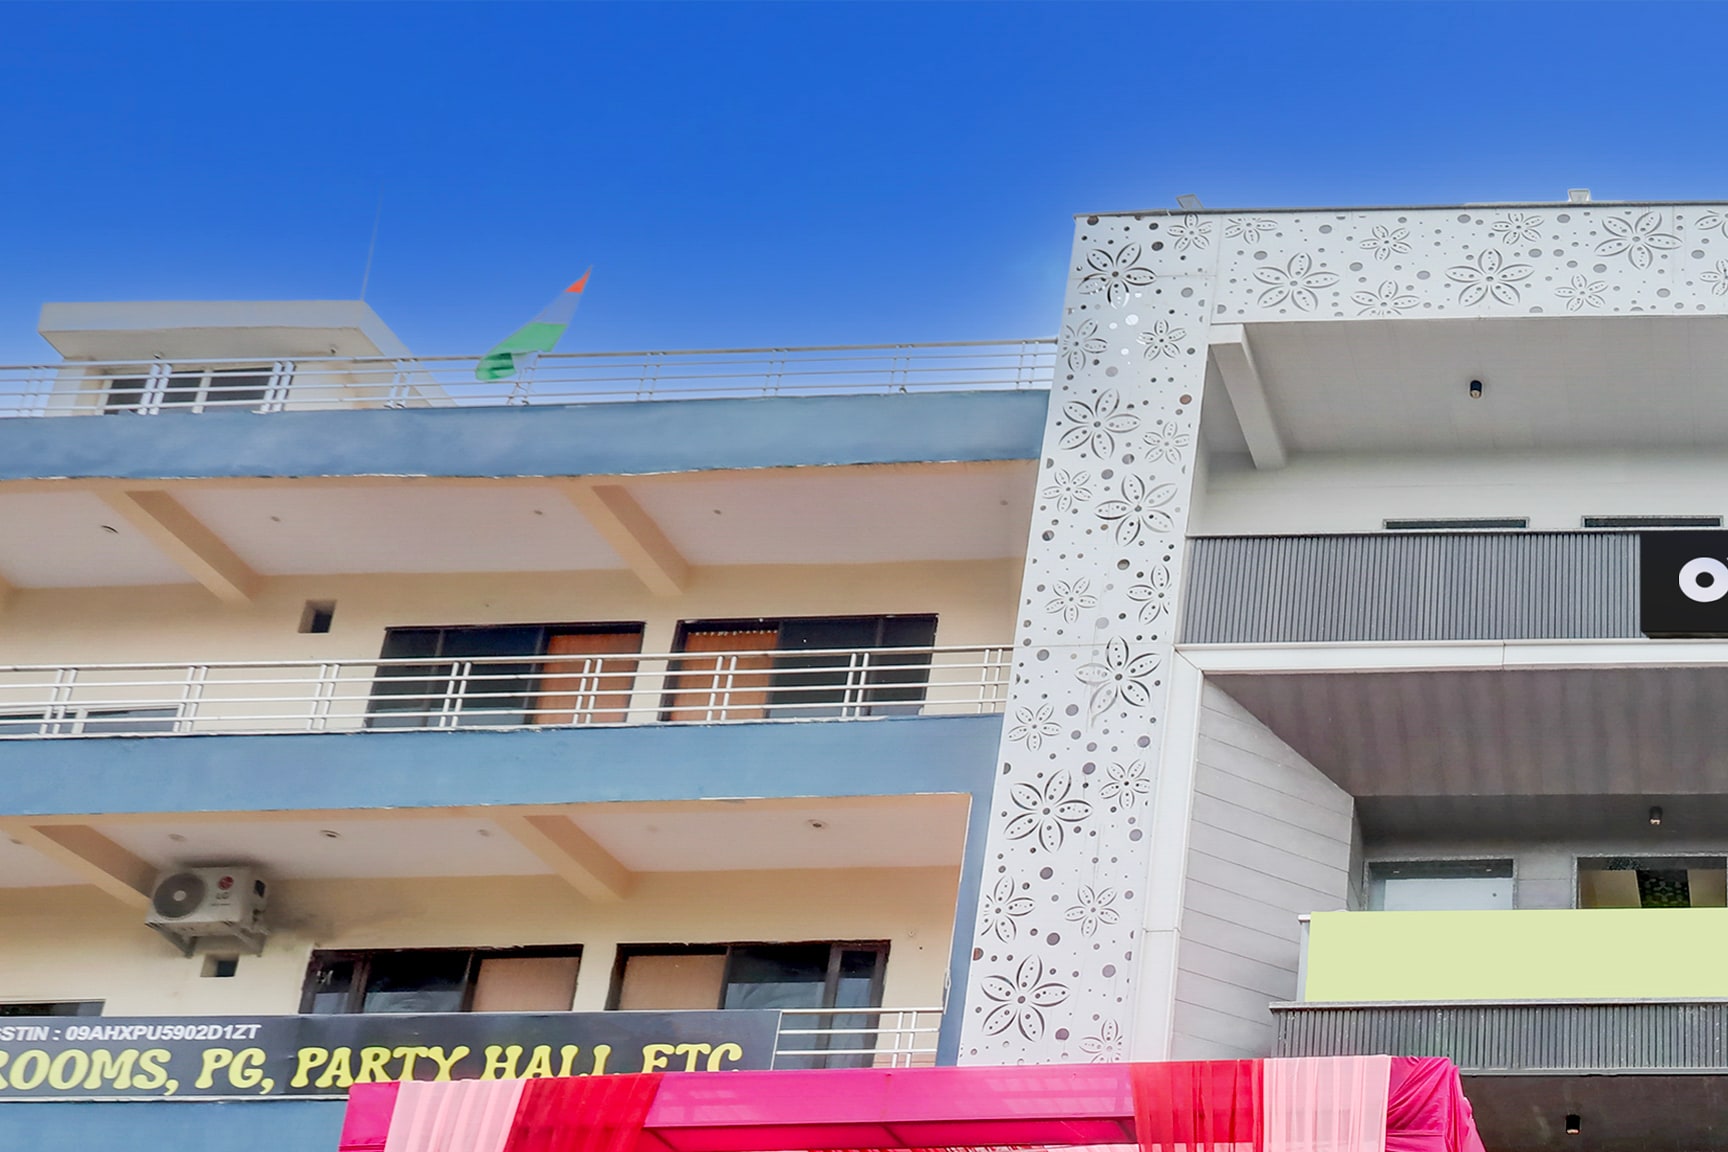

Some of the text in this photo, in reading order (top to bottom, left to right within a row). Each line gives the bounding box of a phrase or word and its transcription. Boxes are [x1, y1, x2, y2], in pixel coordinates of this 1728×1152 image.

[0, 1025, 49, 1041] STIN
[65, 1024, 261, 1041] 09AHXPU5902D1ZT
[0, 1048, 179, 1096] OOMS,
[195, 1047, 275, 1095] PG,
[290, 1045, 471, 1088] PARTY
